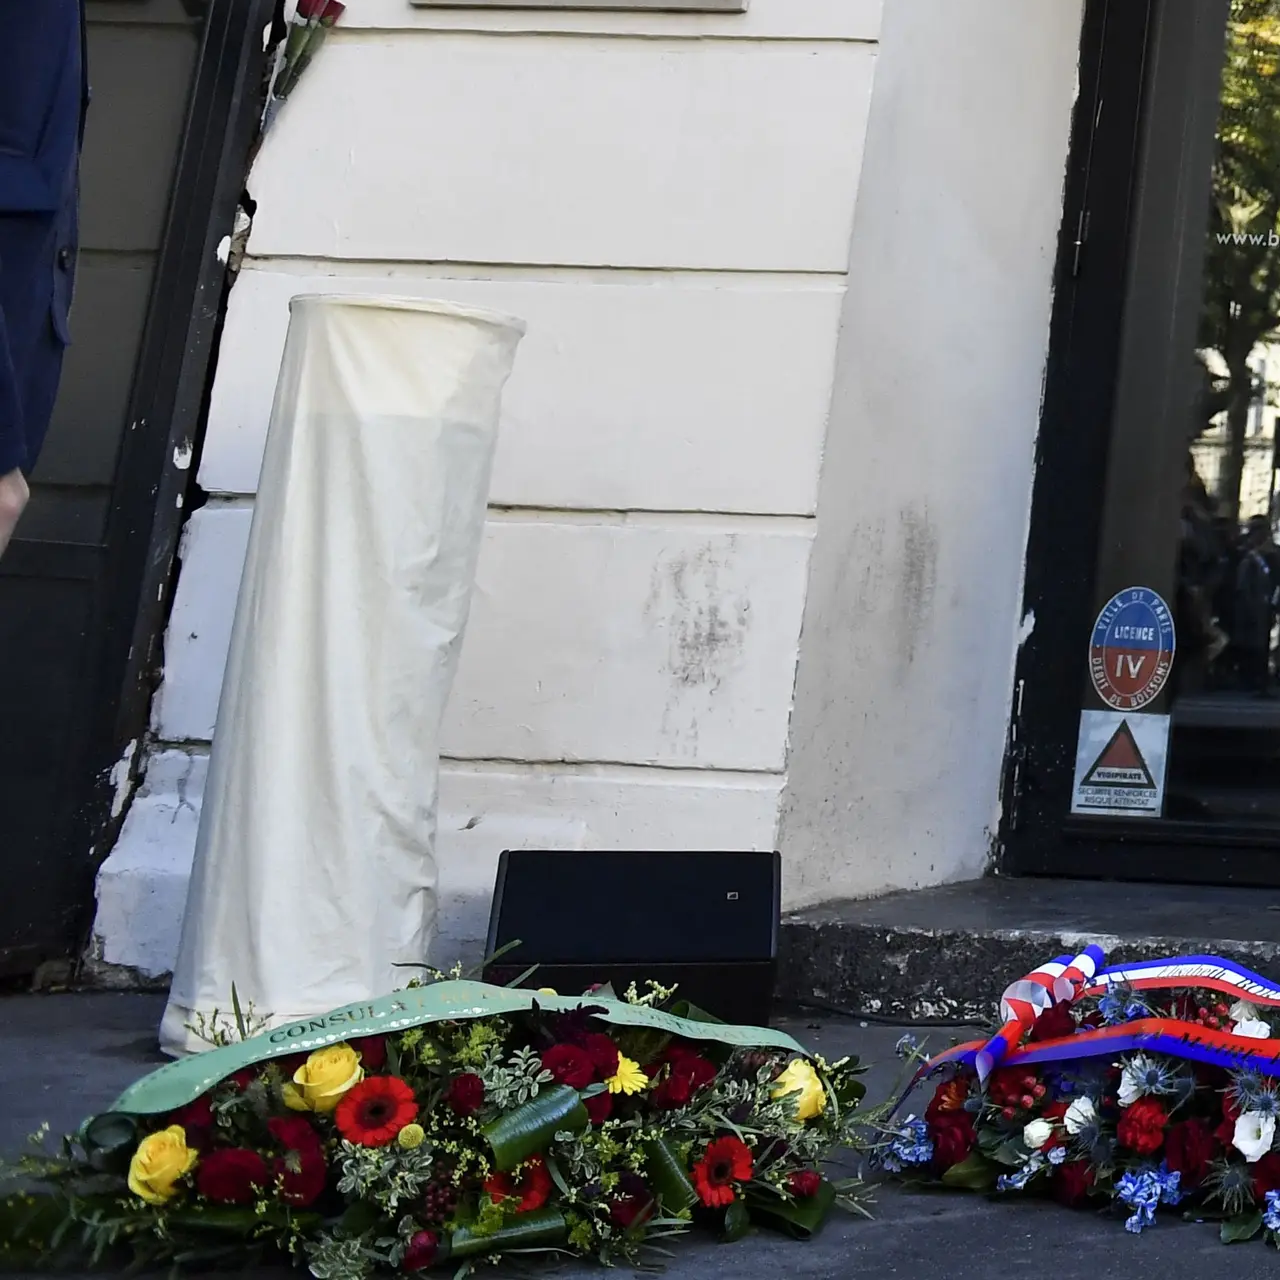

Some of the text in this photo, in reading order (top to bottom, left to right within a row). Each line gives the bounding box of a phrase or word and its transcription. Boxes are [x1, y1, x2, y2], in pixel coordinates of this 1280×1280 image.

[1097, 598, 1124, 631] VILLE
[1148, 598, 1172, 634] PARIS
[1114, 625, 1156, 641] LICENCE
[1115, 654, 1147, 679] IV
[1130, 660, 1169, 707] BOISSONS
